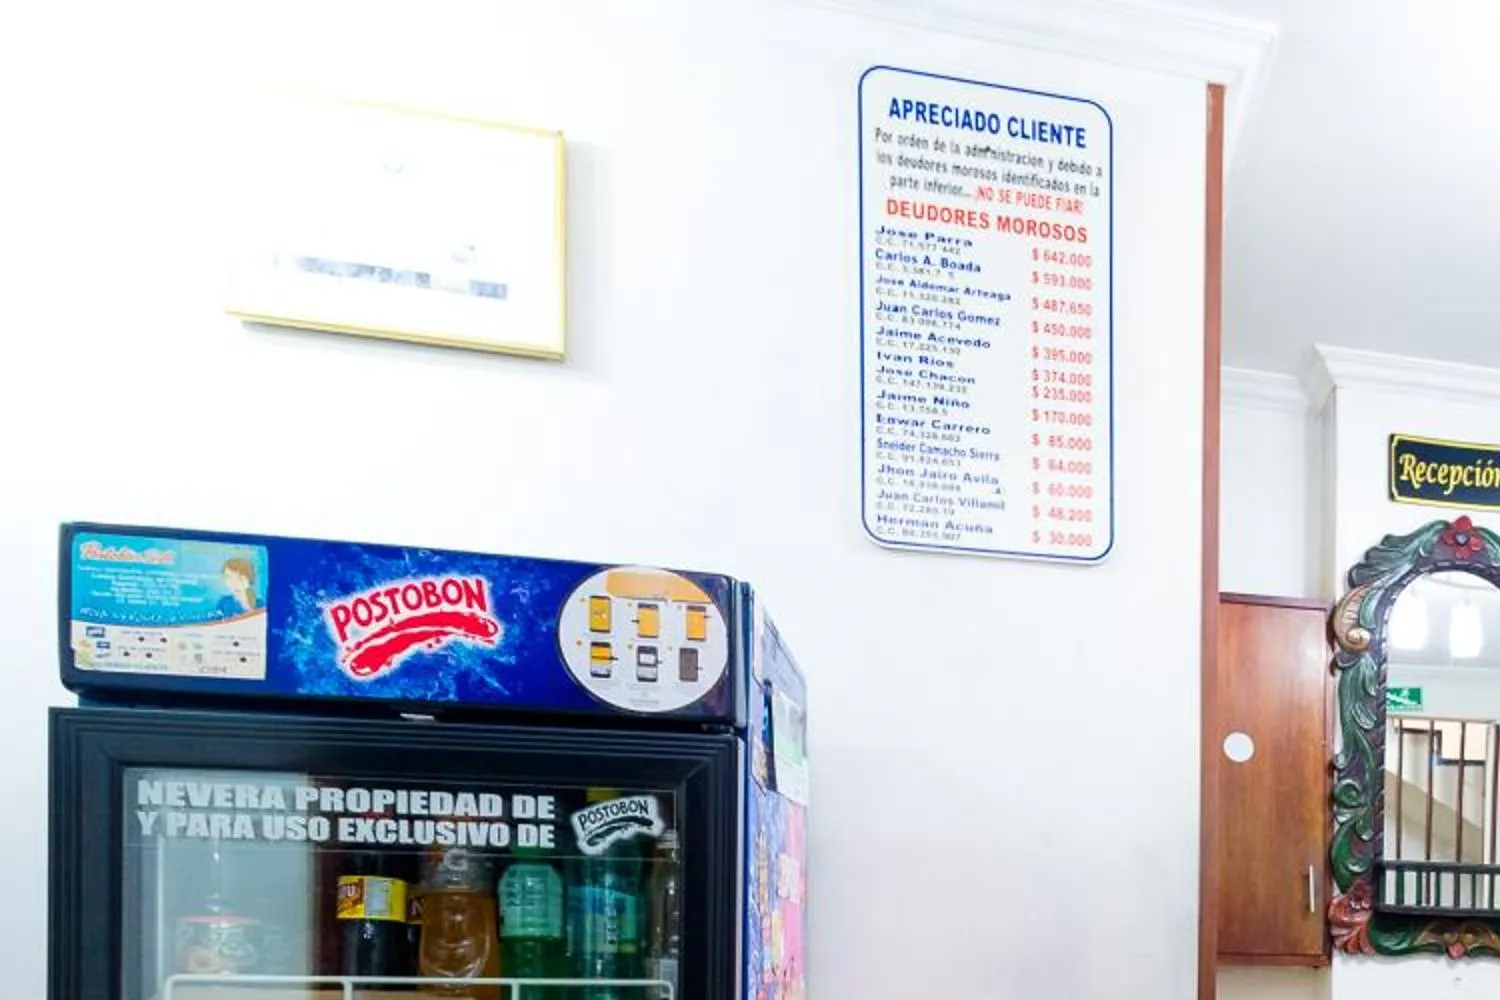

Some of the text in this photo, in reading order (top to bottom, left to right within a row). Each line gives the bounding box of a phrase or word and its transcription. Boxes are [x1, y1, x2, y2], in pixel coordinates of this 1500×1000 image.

[889, 98, 1087, 148] APRECIADO CLIENTE
[875, 127, 893, 143] Por
[898, 134, 929, 150] orden
[933, 137, 947, 152] de
[949, 139, 960, 154] la
[1048, 159, 1054, 173] y
[1058, 158, 1092, 176] debido
[1095, 166, 1102, 178] a
[876, 150, 1100, 197] los deudores morosos identificados en la
[889, 175, 919, 190] parte
[998, 188, 1012, 205] SE
[1015, 190, 1053, 210] PUEDE
[887, 198, 1088, 243] DEUDORES MOROSOS
[924, 232, 973, 247] Parra
[875, 248, 918, 263] Carlos
[940, 257, 981, 273] Boada
[964, 287, 1012, 302] Arteaga
[876, 300, 907, 314] Juan
[911, 304, 953, 320] Carlos
[957, 310, 1001, 327] Gomez
[876, 326, 923, 340] Jaime
[927, 332, 991, 349] Acevedo
[877, 351, 913, 364] Ivan
[918, 369, 977, 385] Chacon
[876, 389, 928, 403] Jaime
[930, 419, 991, 435] Carrero
[919, 441, 967, 458] Camacho
[877, 488, 910, 501] Juan
[913, 493, 955, 507] Carlos
[328, 577, 488, 643] POSTOBON
[137, 780, 556, 820] NEVERA PROPIEDAD DE
[577, 799, 650, 831] POSTOBON
[137, 810, 556, 848] Y PARA USO EXCLUSIVO DE
